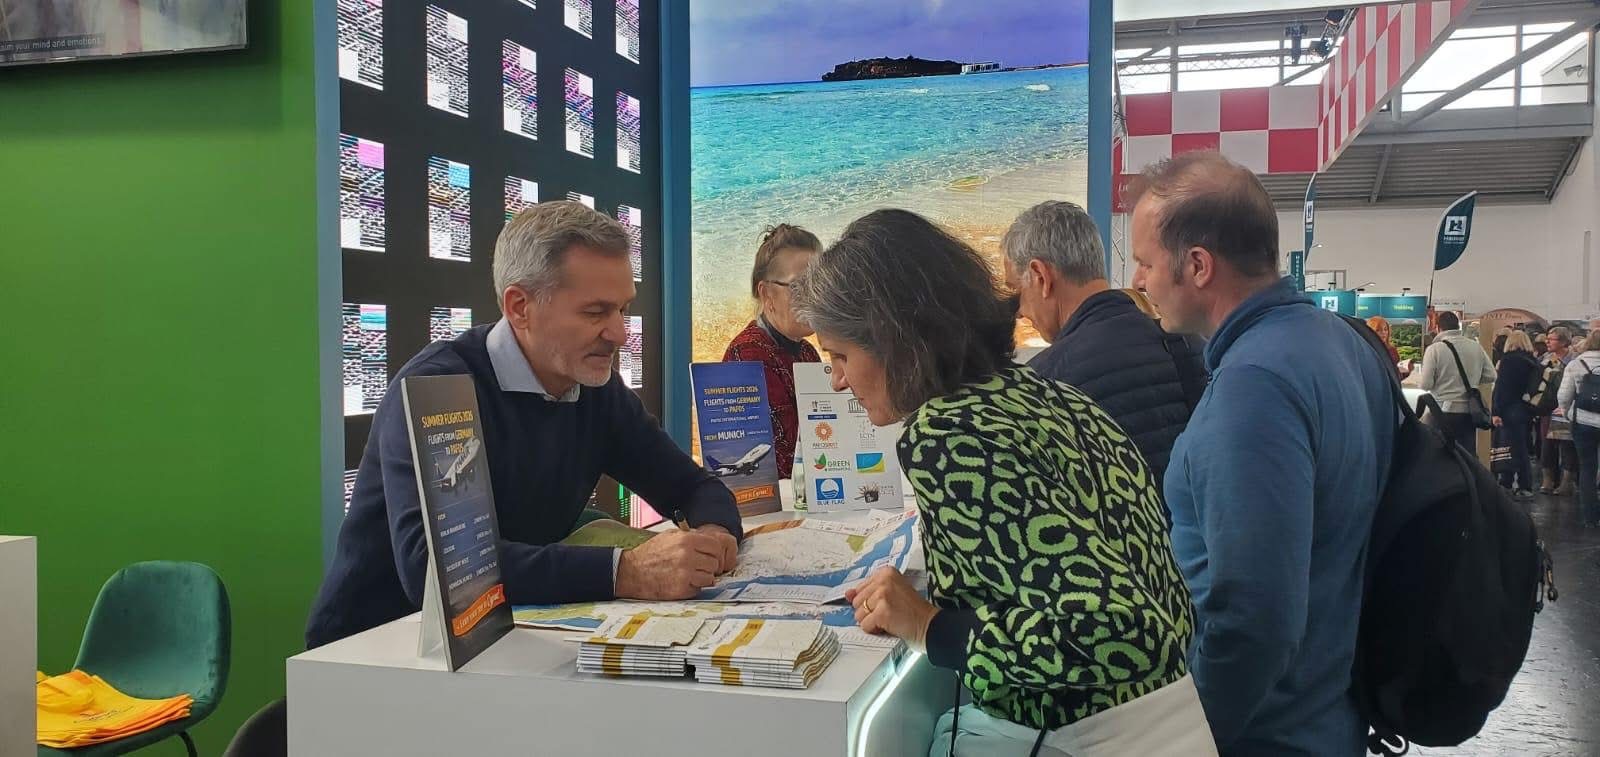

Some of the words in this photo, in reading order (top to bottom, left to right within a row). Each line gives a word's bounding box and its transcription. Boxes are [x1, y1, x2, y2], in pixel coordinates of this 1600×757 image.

[32, 41, 51, 49] mind
[52, 40, 65, 48] and
[704, 387, 726, 395] SUMMER
[727, 386, 746, 394] FLIGHTS
[746, 385, 759, 393] 2026
[704, 398, 725, 407] FLIGHTS
[736, 396, 761, 404] GERMANY
[421, 413, 445, 428] SUMMER
[445, 411, 462, 426] FLIGHTS
[428, 431, 446, 446] FLIGHTS
[717, 429, 745, 441] MUNICH
[827, 459, 850, 467] GREEN
